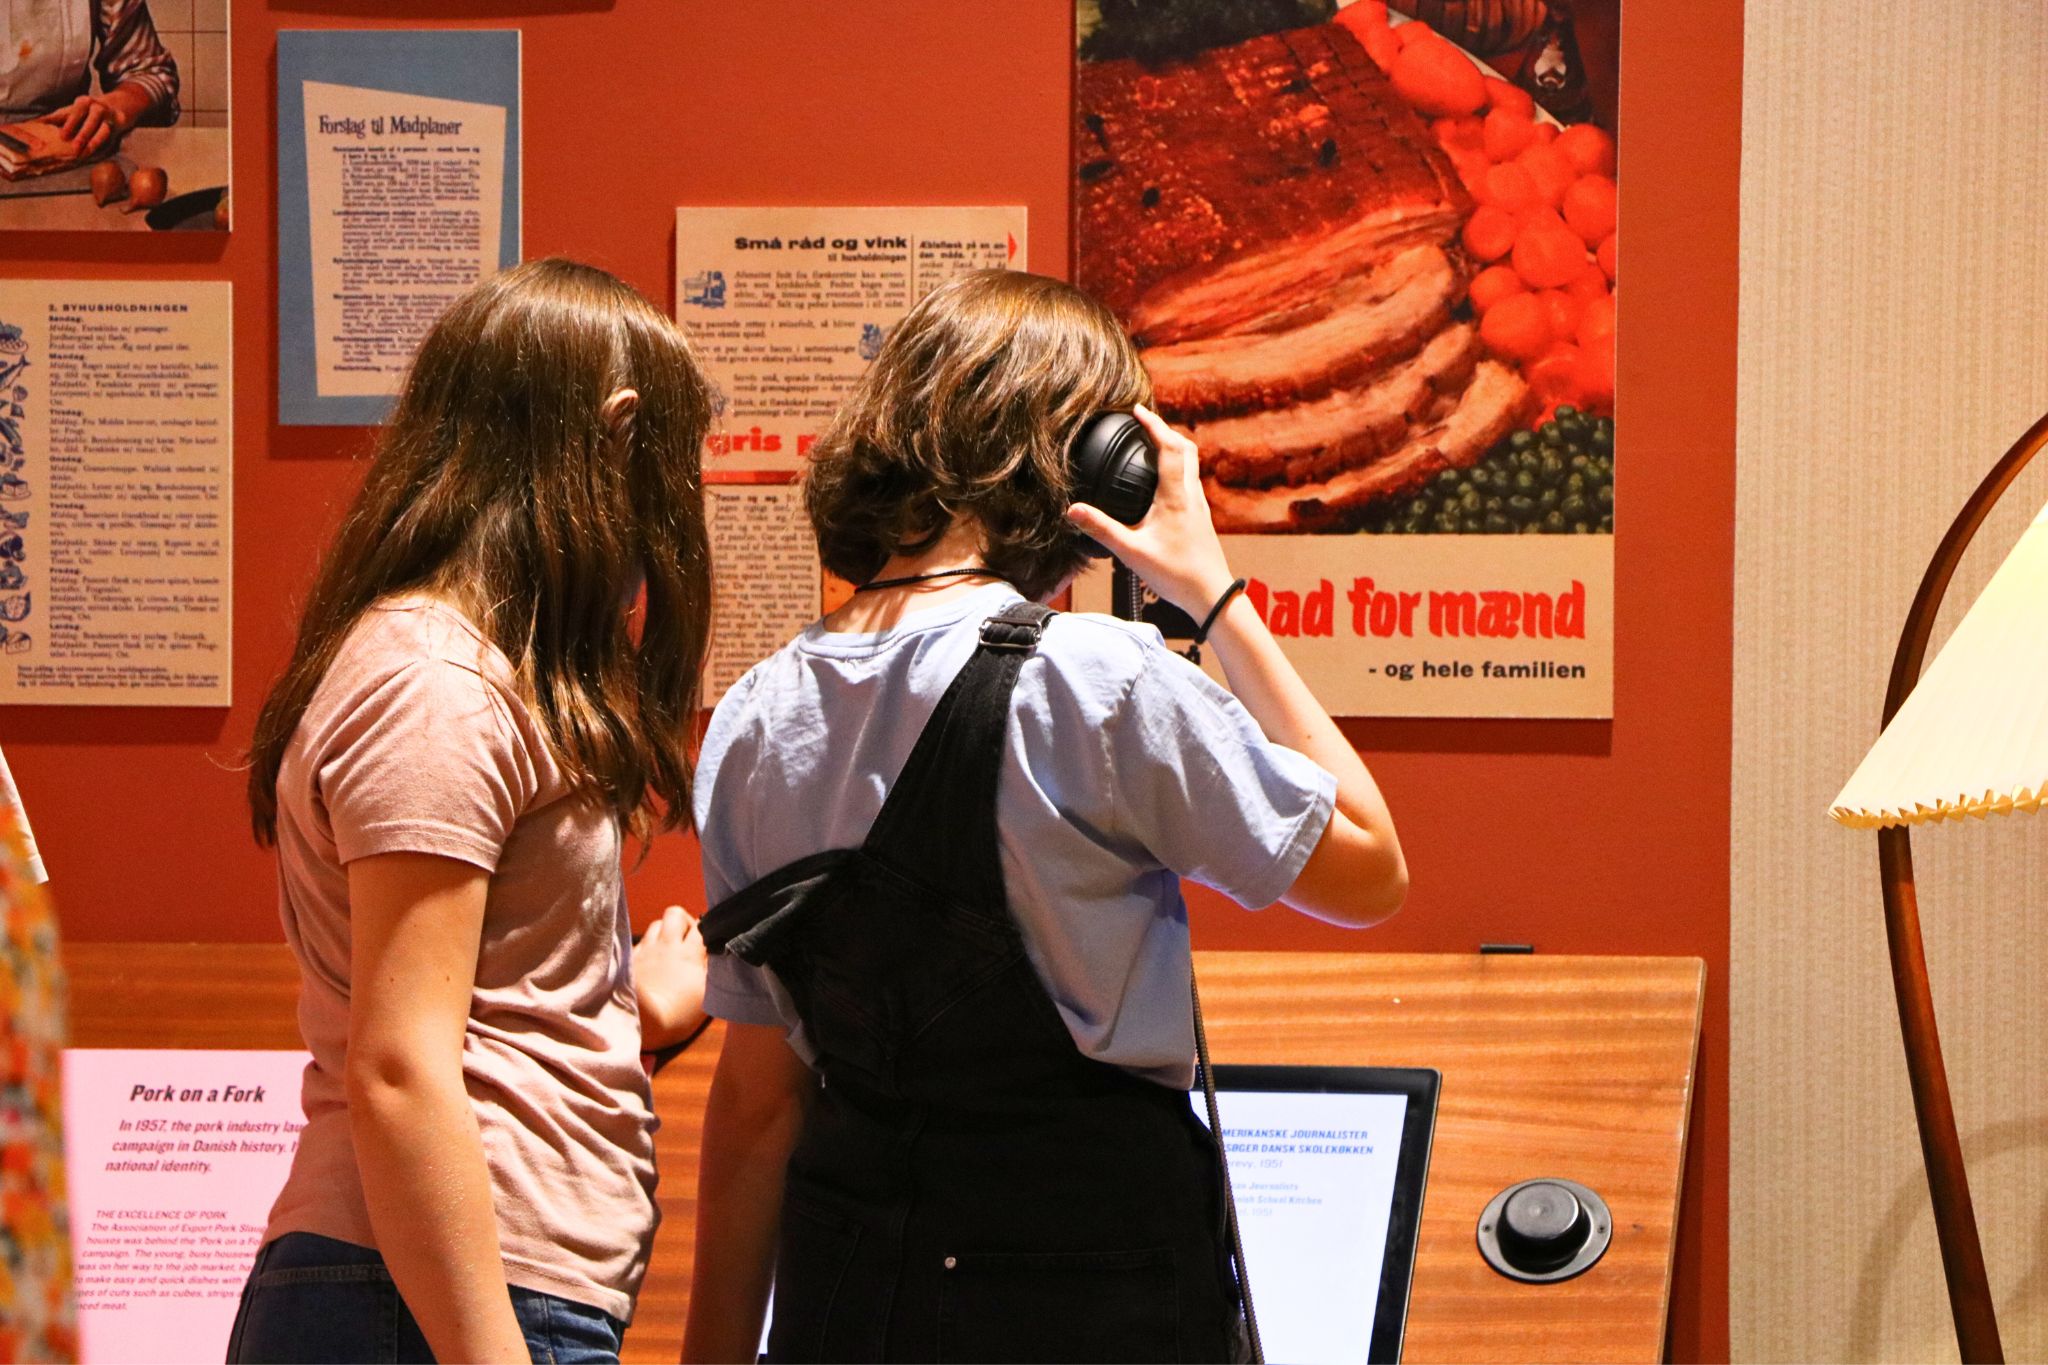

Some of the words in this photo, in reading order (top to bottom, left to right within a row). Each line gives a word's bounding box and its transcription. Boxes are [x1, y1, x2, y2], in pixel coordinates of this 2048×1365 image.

[319, 115, 365, 138] Forslag
[371, 116, 384, 135] til
[391, 116, 461, 138] Madplaner
[735, 237, 782, 249] Små
[788, 237, 825, 249] råd
[831, 239, 857, 250] og
[865, 237, 906, 248] vink
[828, 253, 836, 261] til
[841, 254, 906, 262] husholdningen
[706, 426, 782, 457] gris
[1347, 577, 1421, 638] for
[1429, 580, 1586, 640] mænd
[1385, 664, 1414, 680] og
[1422, 661, 1473, 677] hele
[1482, 661, 1584, 678] familien
[130, 1085, 174, 1101] Pork
[180, 1089, 202, 1101] on
[206, 1090, 218, 1101] a
[223, 1085, 264, 1102] Fork
[119, 1120, 131, 1130] In
[171, 1120, 191, 1131] the
[194, 1121, 222, 1133] pork
[227, 1122, 279, 1132] industry
[1222, 1129, 1288, 1138] MERIKANSKE
[1292, 1130, 1367, 1138] JOURNALISTER
[113, 1142, 173, 1153] campaign
[193, 1140, 236, 1151] Danish
[239, 1140, 286, 1155] history.
[1226, 1143, 1259, 1153] SØGER
[1300, 1145, 1372, 1153] SKOLEKØKKEN
[106, 1161, 159, 1171] national
[161, 1160, 211, 1174] identity.
[1230, 1160, 1256, 1169] revy,
[1260, 1159, 1284, 1169] 1951
[97, 1210, 114, 1218] THE
[184, 1211, 196, 1219] OF
